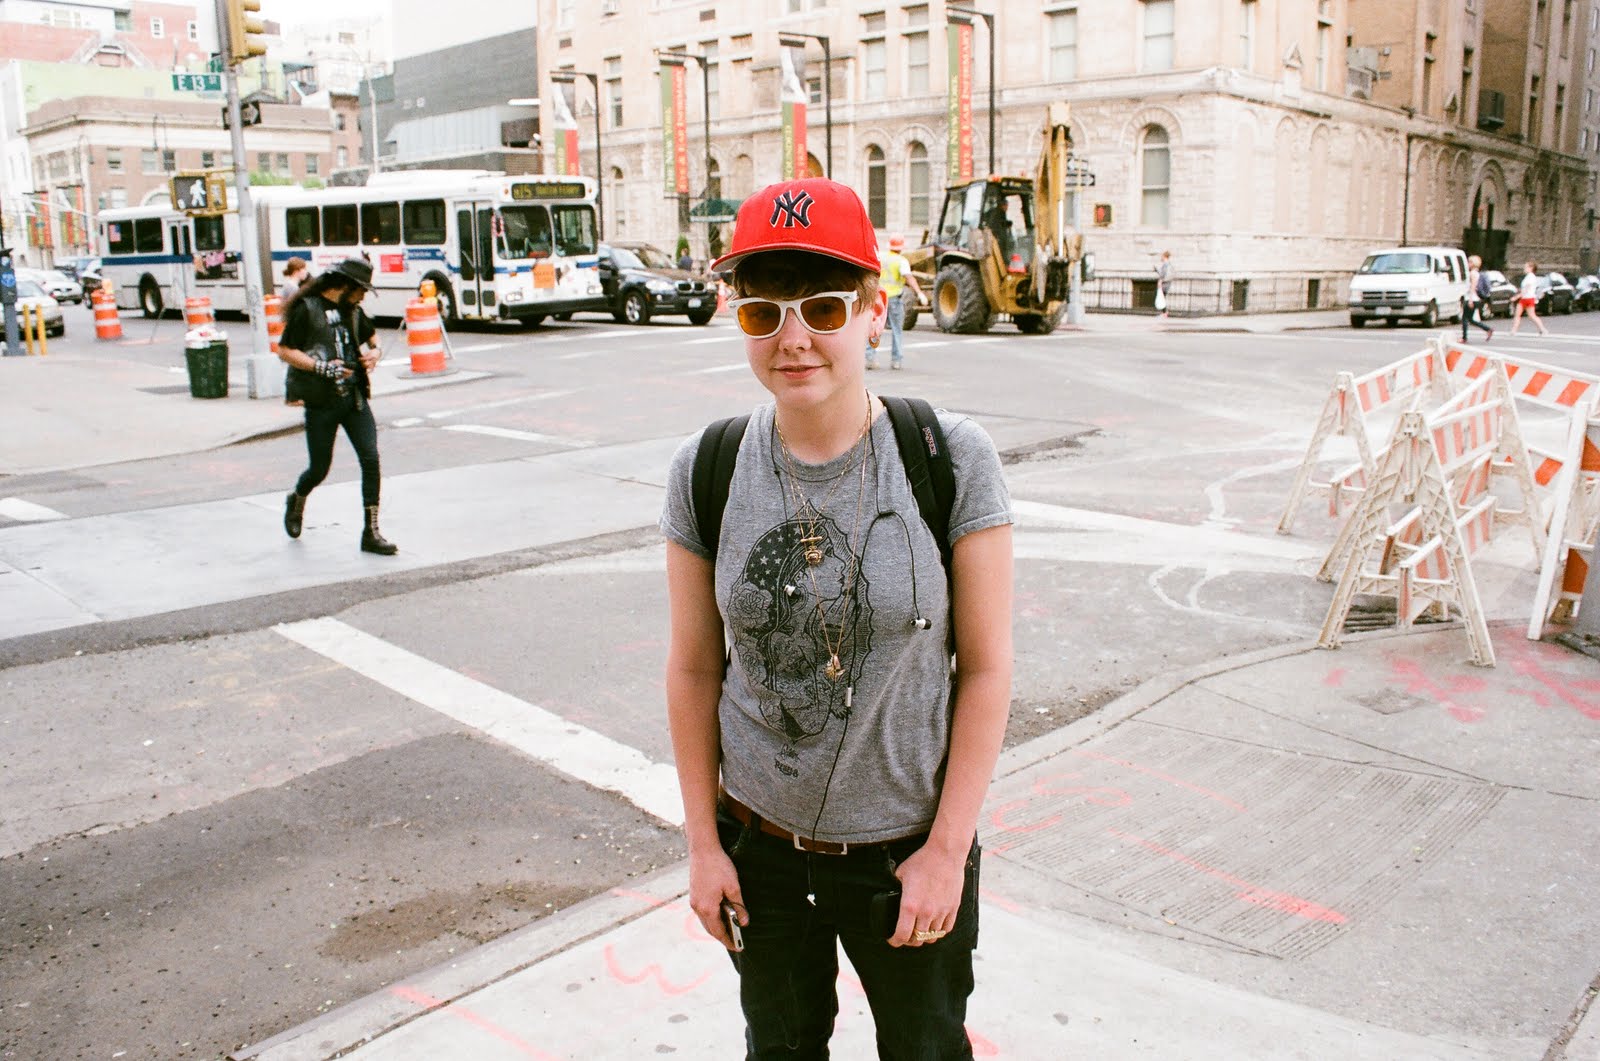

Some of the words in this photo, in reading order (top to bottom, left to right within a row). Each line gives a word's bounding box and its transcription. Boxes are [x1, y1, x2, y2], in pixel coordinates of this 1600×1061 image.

[961, 30, 970, 99] INFIRMARY
[178, 75, 187, 90] E
[191, 75, 205, 90] 13
[951, 114, 959, 145] NEW
[961, 104, 970, 131] EAR
[665, 139, 673, 165] NEW
[951, 149, 959, 175] THE
[961, 150, 970, 177] EYE
[770, 189, 815, 229] NY
